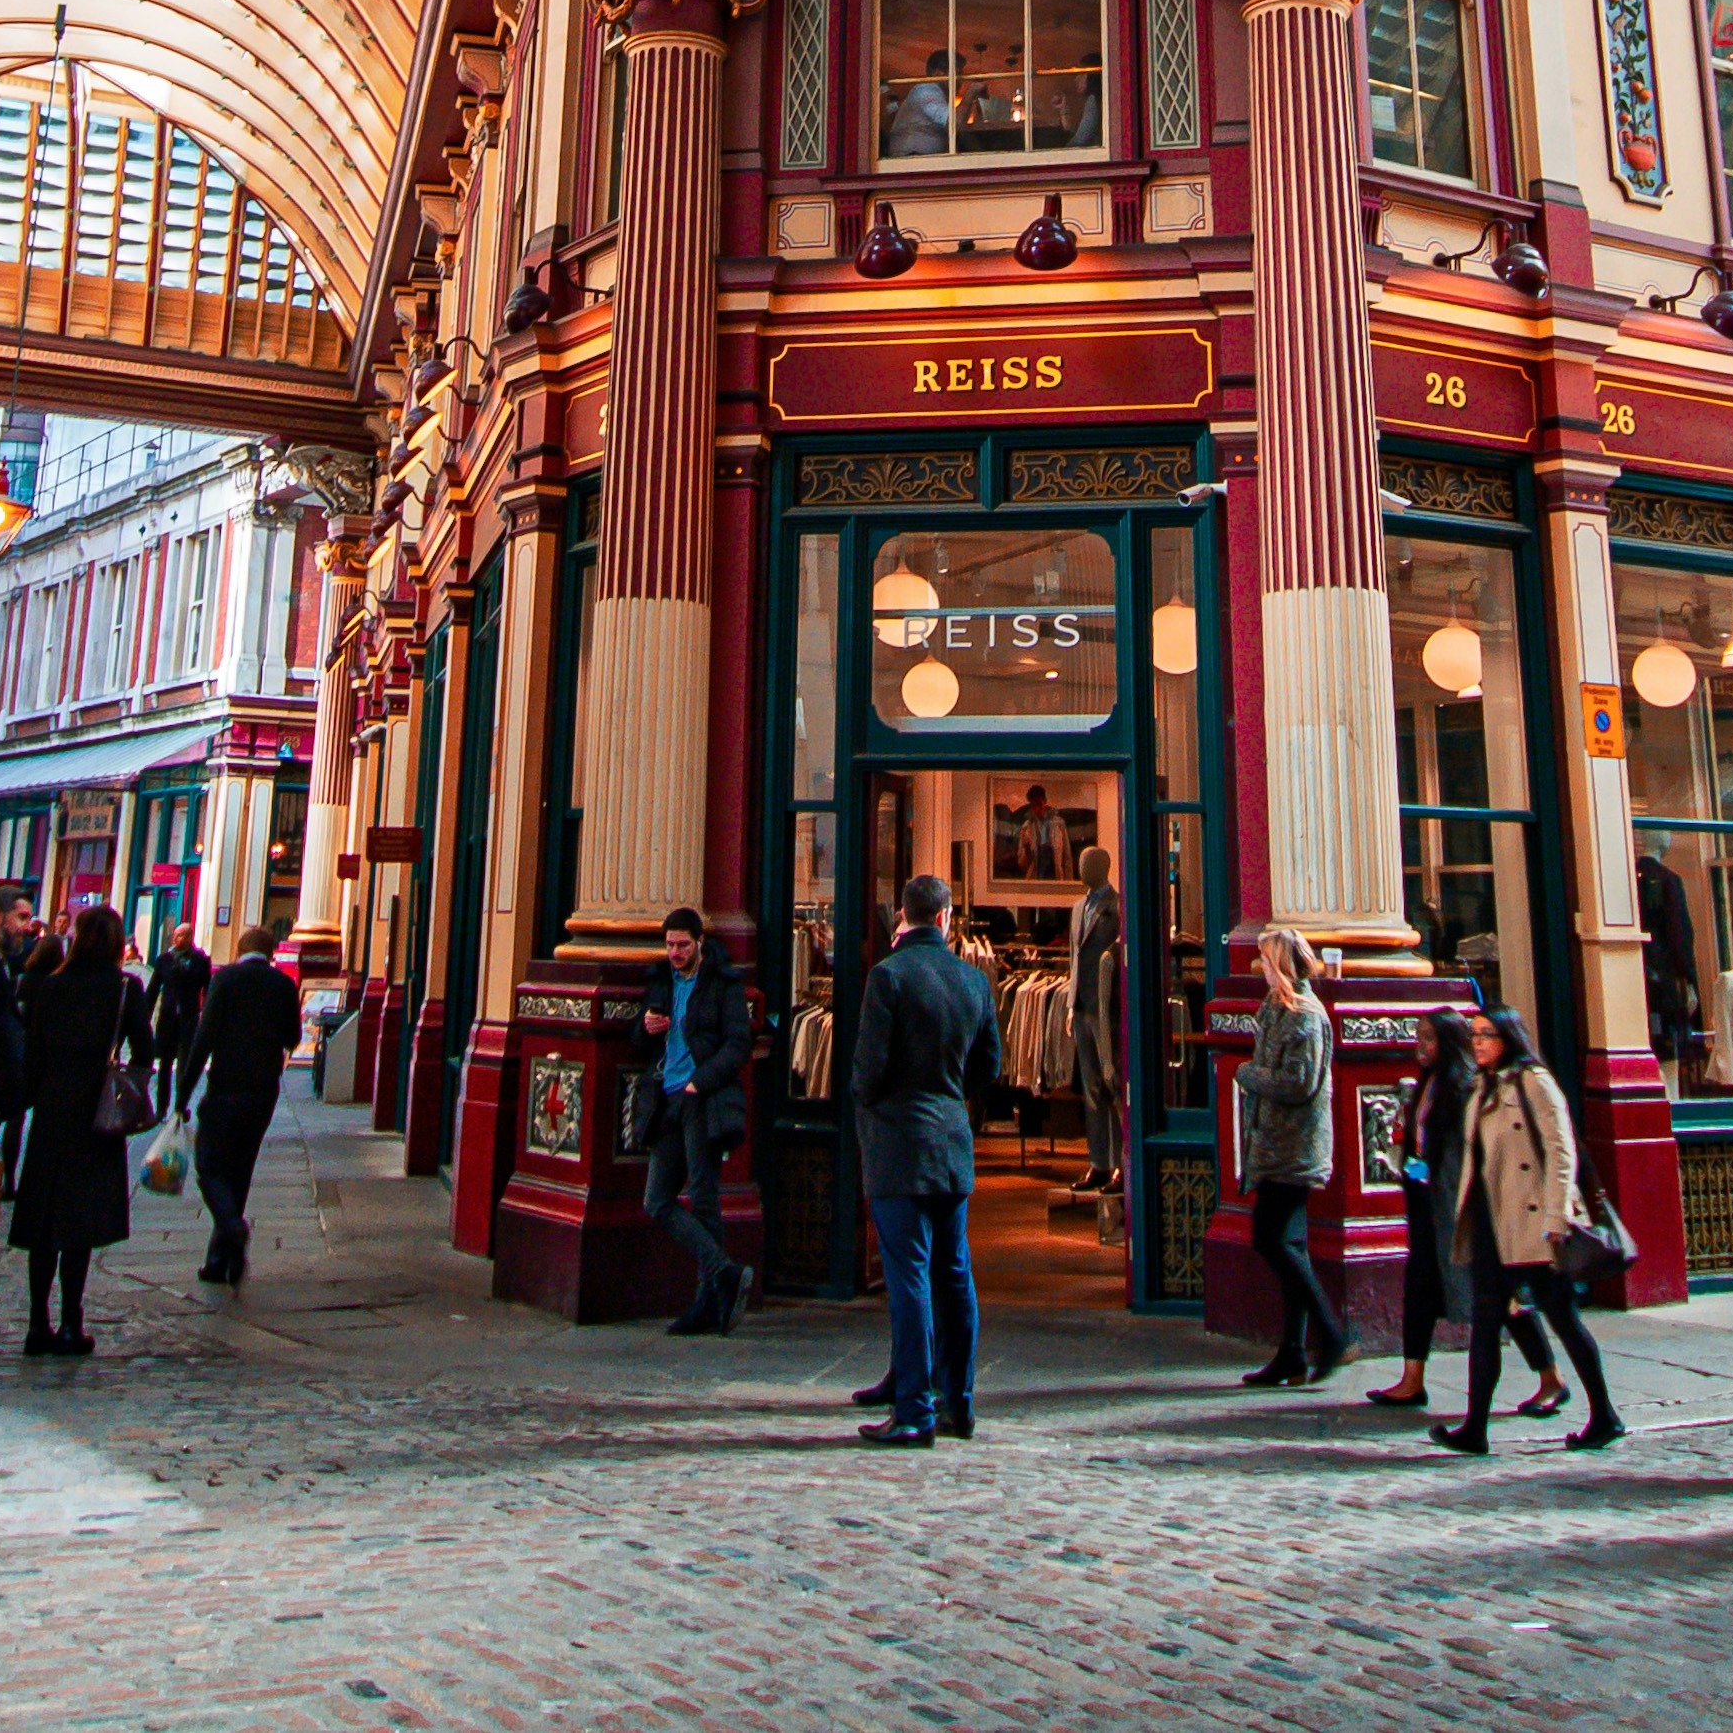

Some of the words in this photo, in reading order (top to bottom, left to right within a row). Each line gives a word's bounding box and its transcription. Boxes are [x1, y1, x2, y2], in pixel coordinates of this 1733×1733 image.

[913, 355, 1063, 392] REISS
[1425, 372, 1466, 408] 26
[1600, 402, 1635, 435] 26
[903, 614, 1080, 649] REISS
